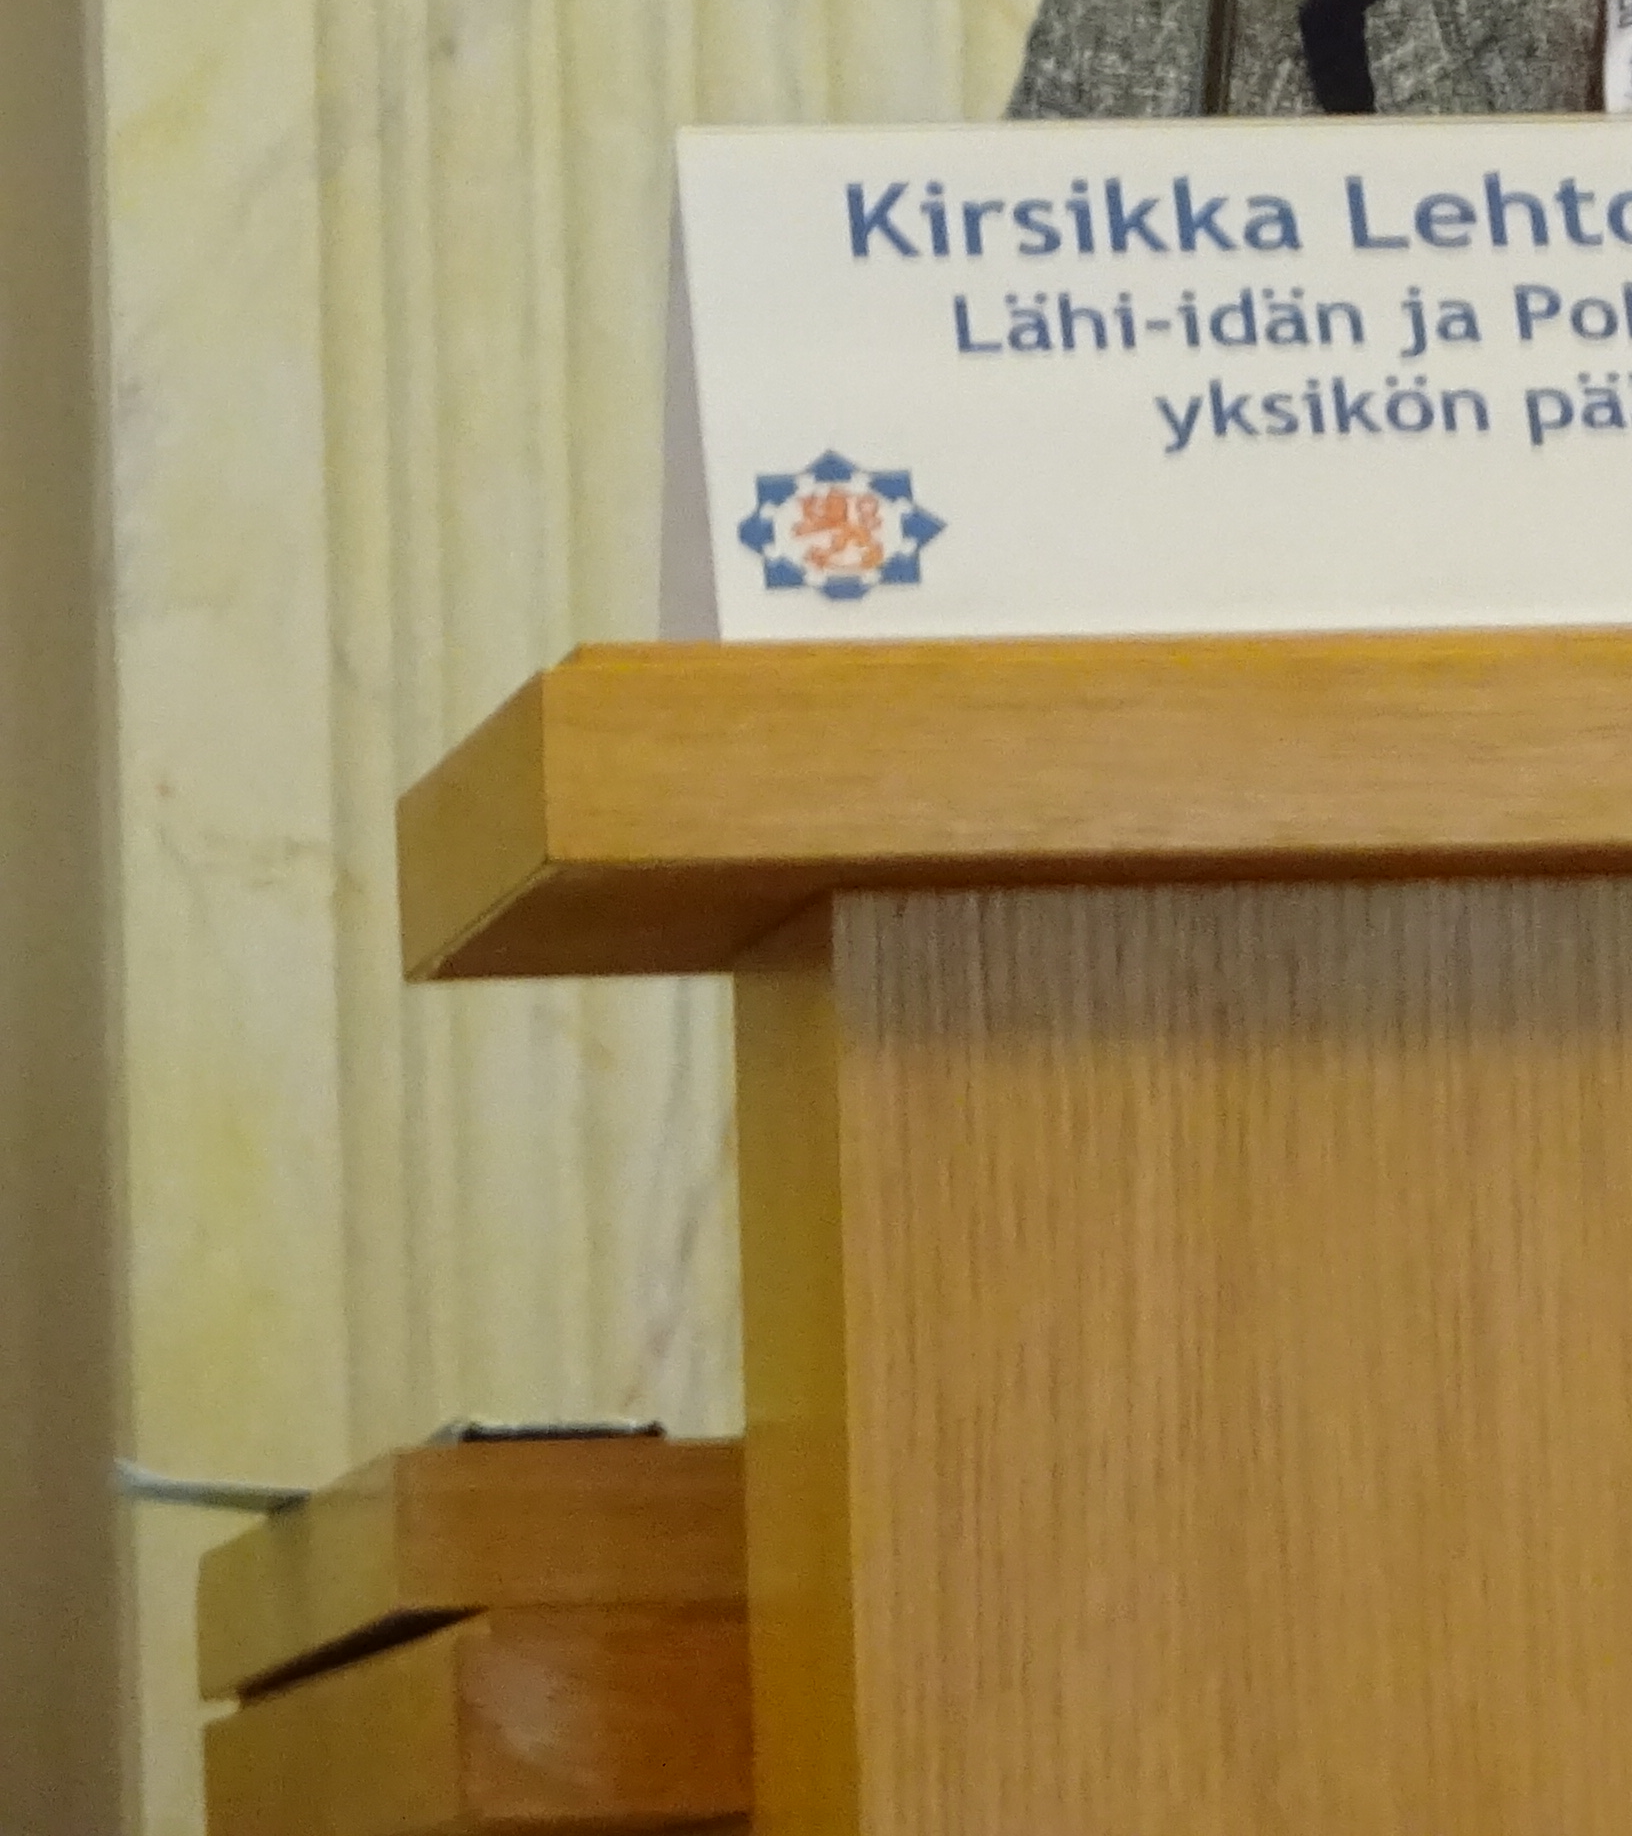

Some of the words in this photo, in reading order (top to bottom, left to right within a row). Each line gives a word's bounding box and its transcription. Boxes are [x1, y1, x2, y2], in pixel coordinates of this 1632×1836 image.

[844, 175, 1304, 260] Kirsikka
[952, 286, 1366, 354] Lähi-idän
[1399, 298, 1483, 359] ja
[1156, 375, 1492, 454] yksikön
